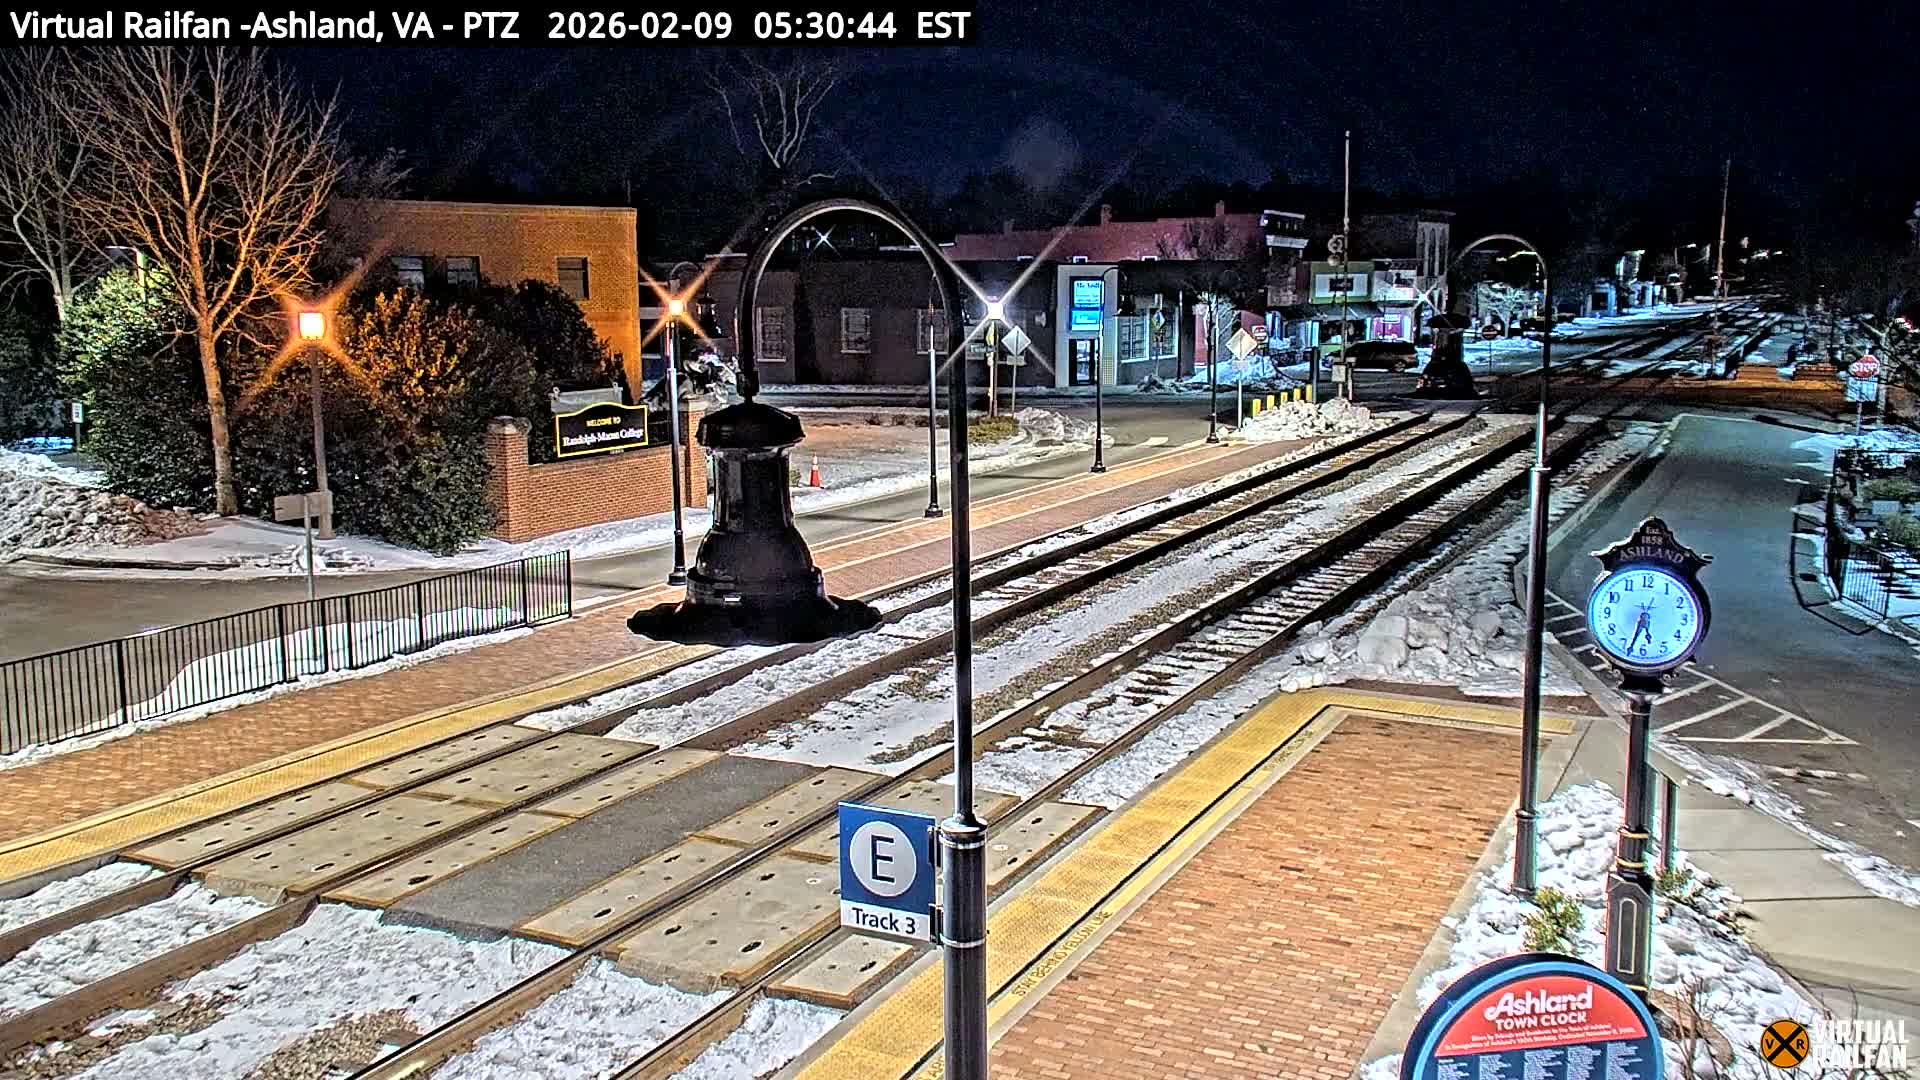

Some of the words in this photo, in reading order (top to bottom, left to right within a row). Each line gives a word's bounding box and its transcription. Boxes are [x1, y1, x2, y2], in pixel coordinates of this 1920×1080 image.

[1853, 362, 1878, 372] STOP
[1619, 547, 1684, 564] ASHLAND
[1624, 579, 1634, 592] 11
[1642, 575, 1654, 589] 12
[1663, 582, 1670, 595] 1
[1608, 591, 1620, 604] 10
[1675, 596, 1684, 609] 2
[1603, 606, 1611, 619] 9
[1680, 613, 1688, 626] 3
[1607, 623, 1616, 636] 8
[1673, 629, 1681, 642] 4
[1620, 637, 1627, 650] 7
[1639, 643, 1647, 657] 6
[1659, 640, 1669, 654] 5
[871, 834, 895, 884] E
[851, 906, 900, 932] Track
[905, 916, 916, 935] 3
[1484, 984, 1593, 1021] Ashland
[1495, 1015, 1538, 1031] TOWN
[1541, 1010, 1587, 1027] CLOCK
